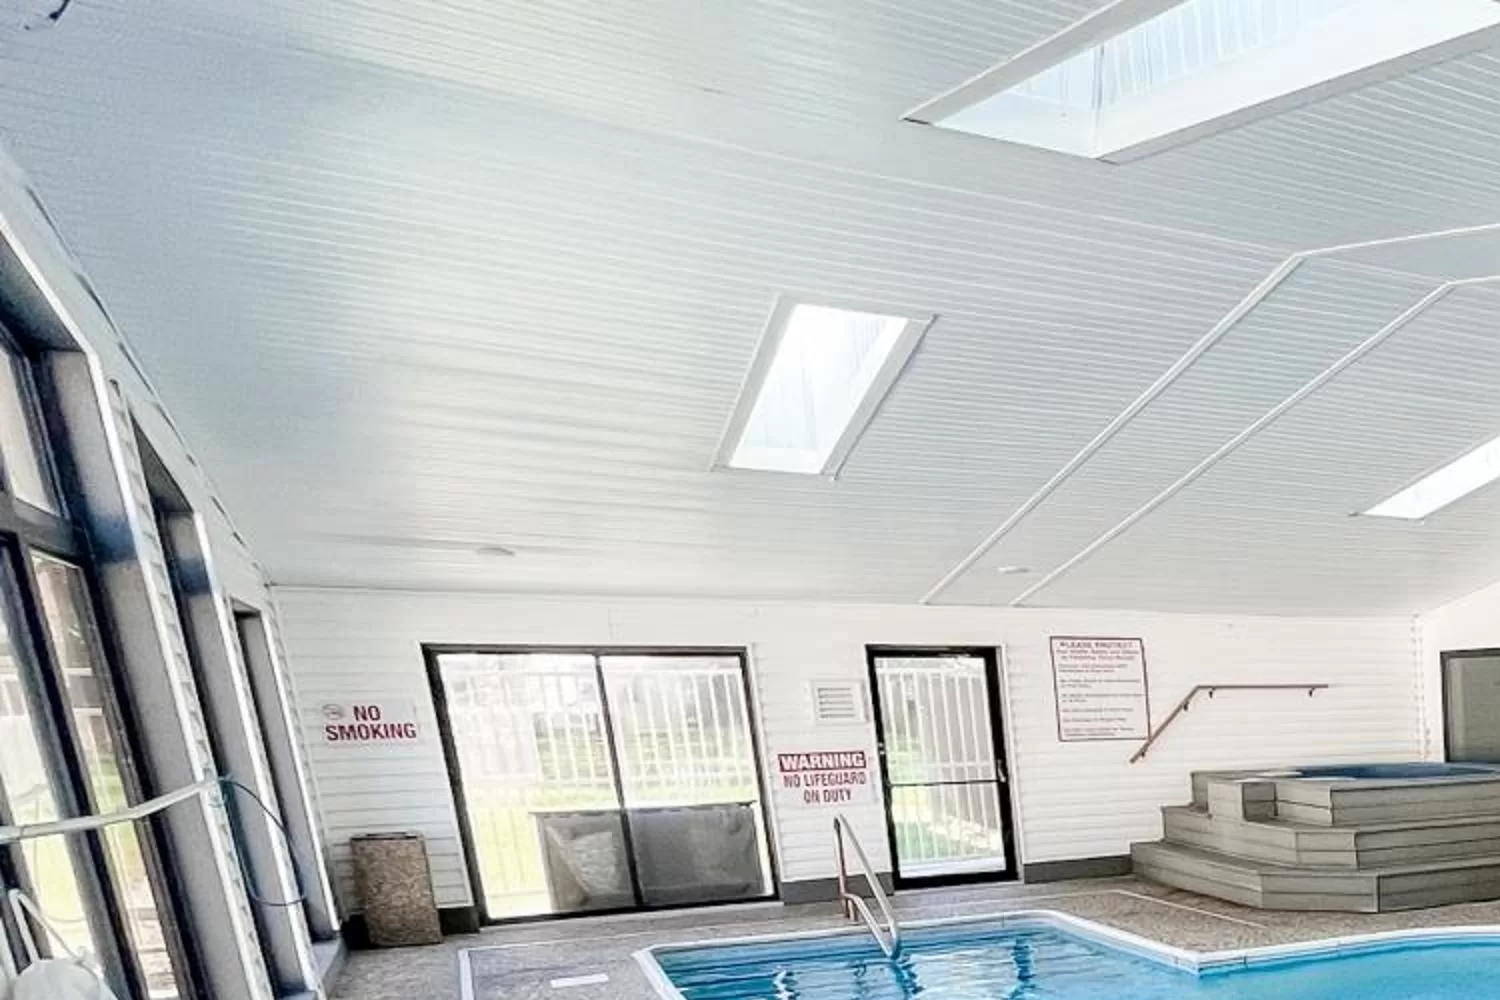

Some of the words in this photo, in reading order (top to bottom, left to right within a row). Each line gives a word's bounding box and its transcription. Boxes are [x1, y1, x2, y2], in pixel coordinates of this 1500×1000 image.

[352, 705, 381, 721] NO
[325, 723, 417, 741] SMOKING
[780, 753, 864, 770] WARNING
[783, 774, 800, 788] NO
[803, 772, 865, 787] LIFEGUARD
[803, 789, 819, 804] ON
[823, 788, 851, 803] DUTY
